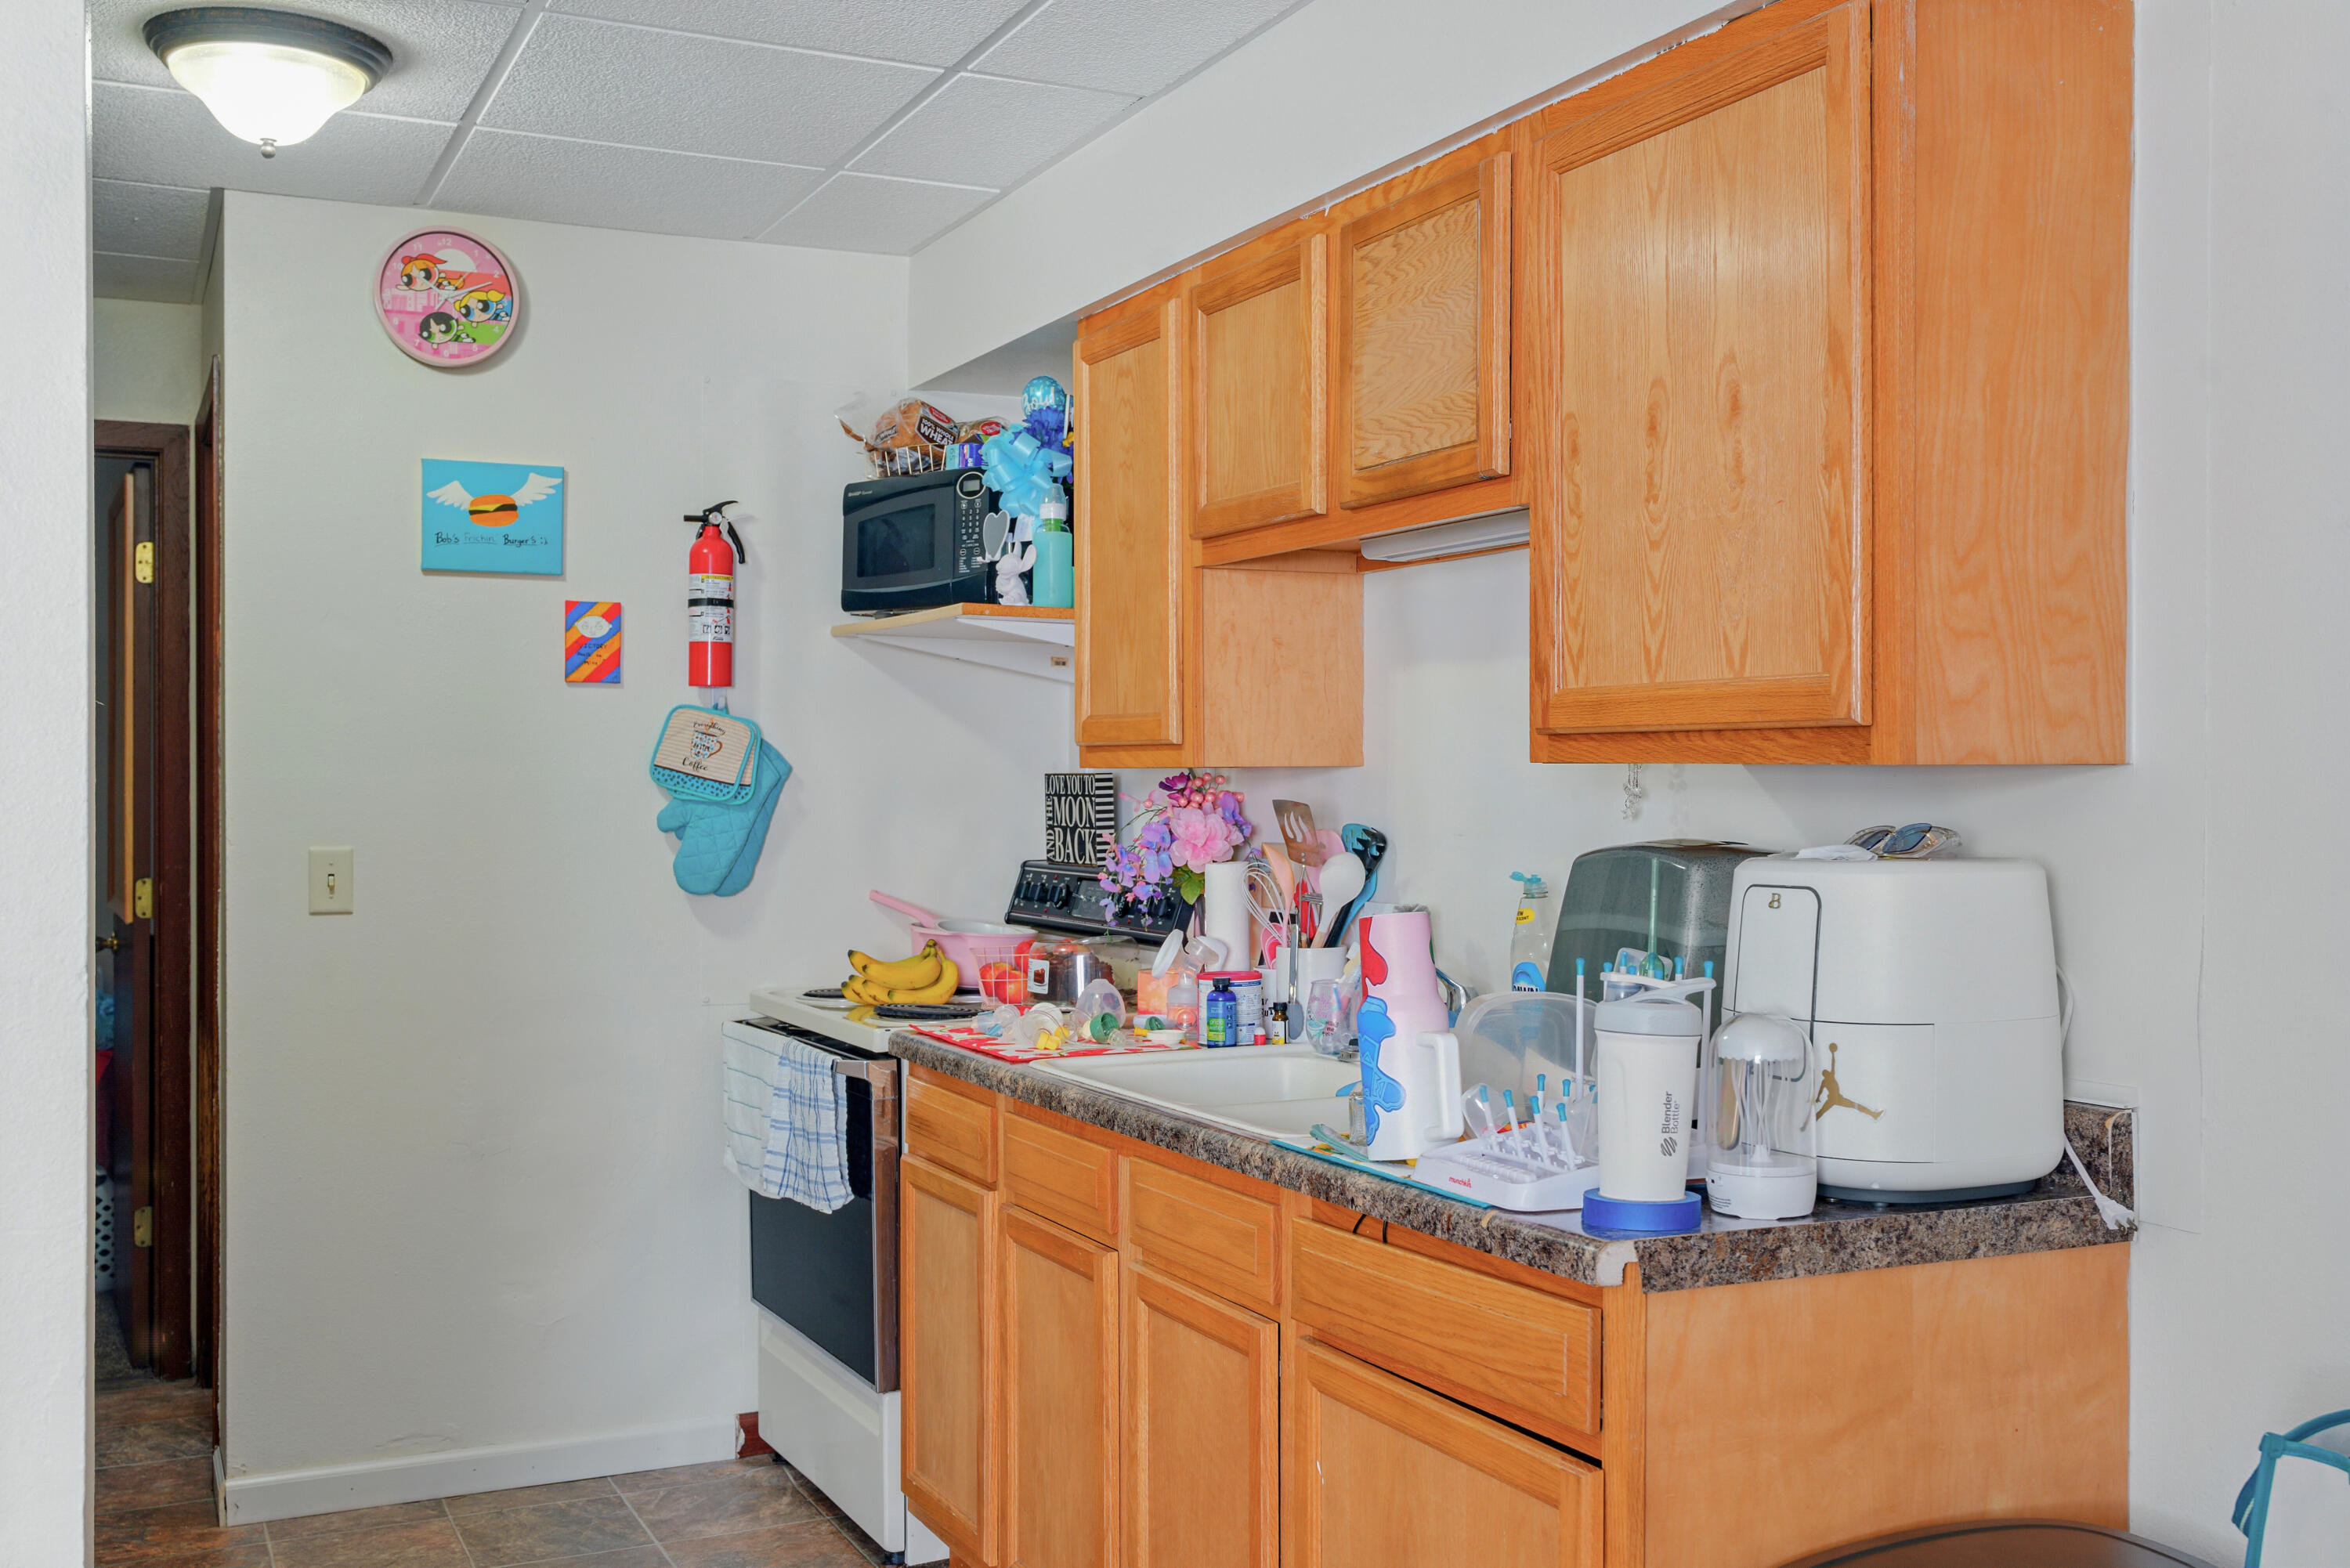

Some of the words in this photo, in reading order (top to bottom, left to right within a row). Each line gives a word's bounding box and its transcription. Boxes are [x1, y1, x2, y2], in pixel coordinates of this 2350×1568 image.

[920, 424, 953, 446] WHEAT
[921, 418, 936, 430] 100%
[935, 426, 954, 442] WHOLE
[435, 532, 460, 544] Bob's
[682, 757, 709, 771] Coffee
[1046, 775, 1065, 795] LOVE
[1066, 775, 1083, 795] YOU
[1083, 775, 1096, 795] TO
[1053, 796, 1096, 828] MOON
[1047, 829, 1055, 860] AND
[1054, 828, 1097, 864] BACK
[1661, 1091, 1673, 1133] Blender
[1670, 1103, 1680, 1133] Bottle
